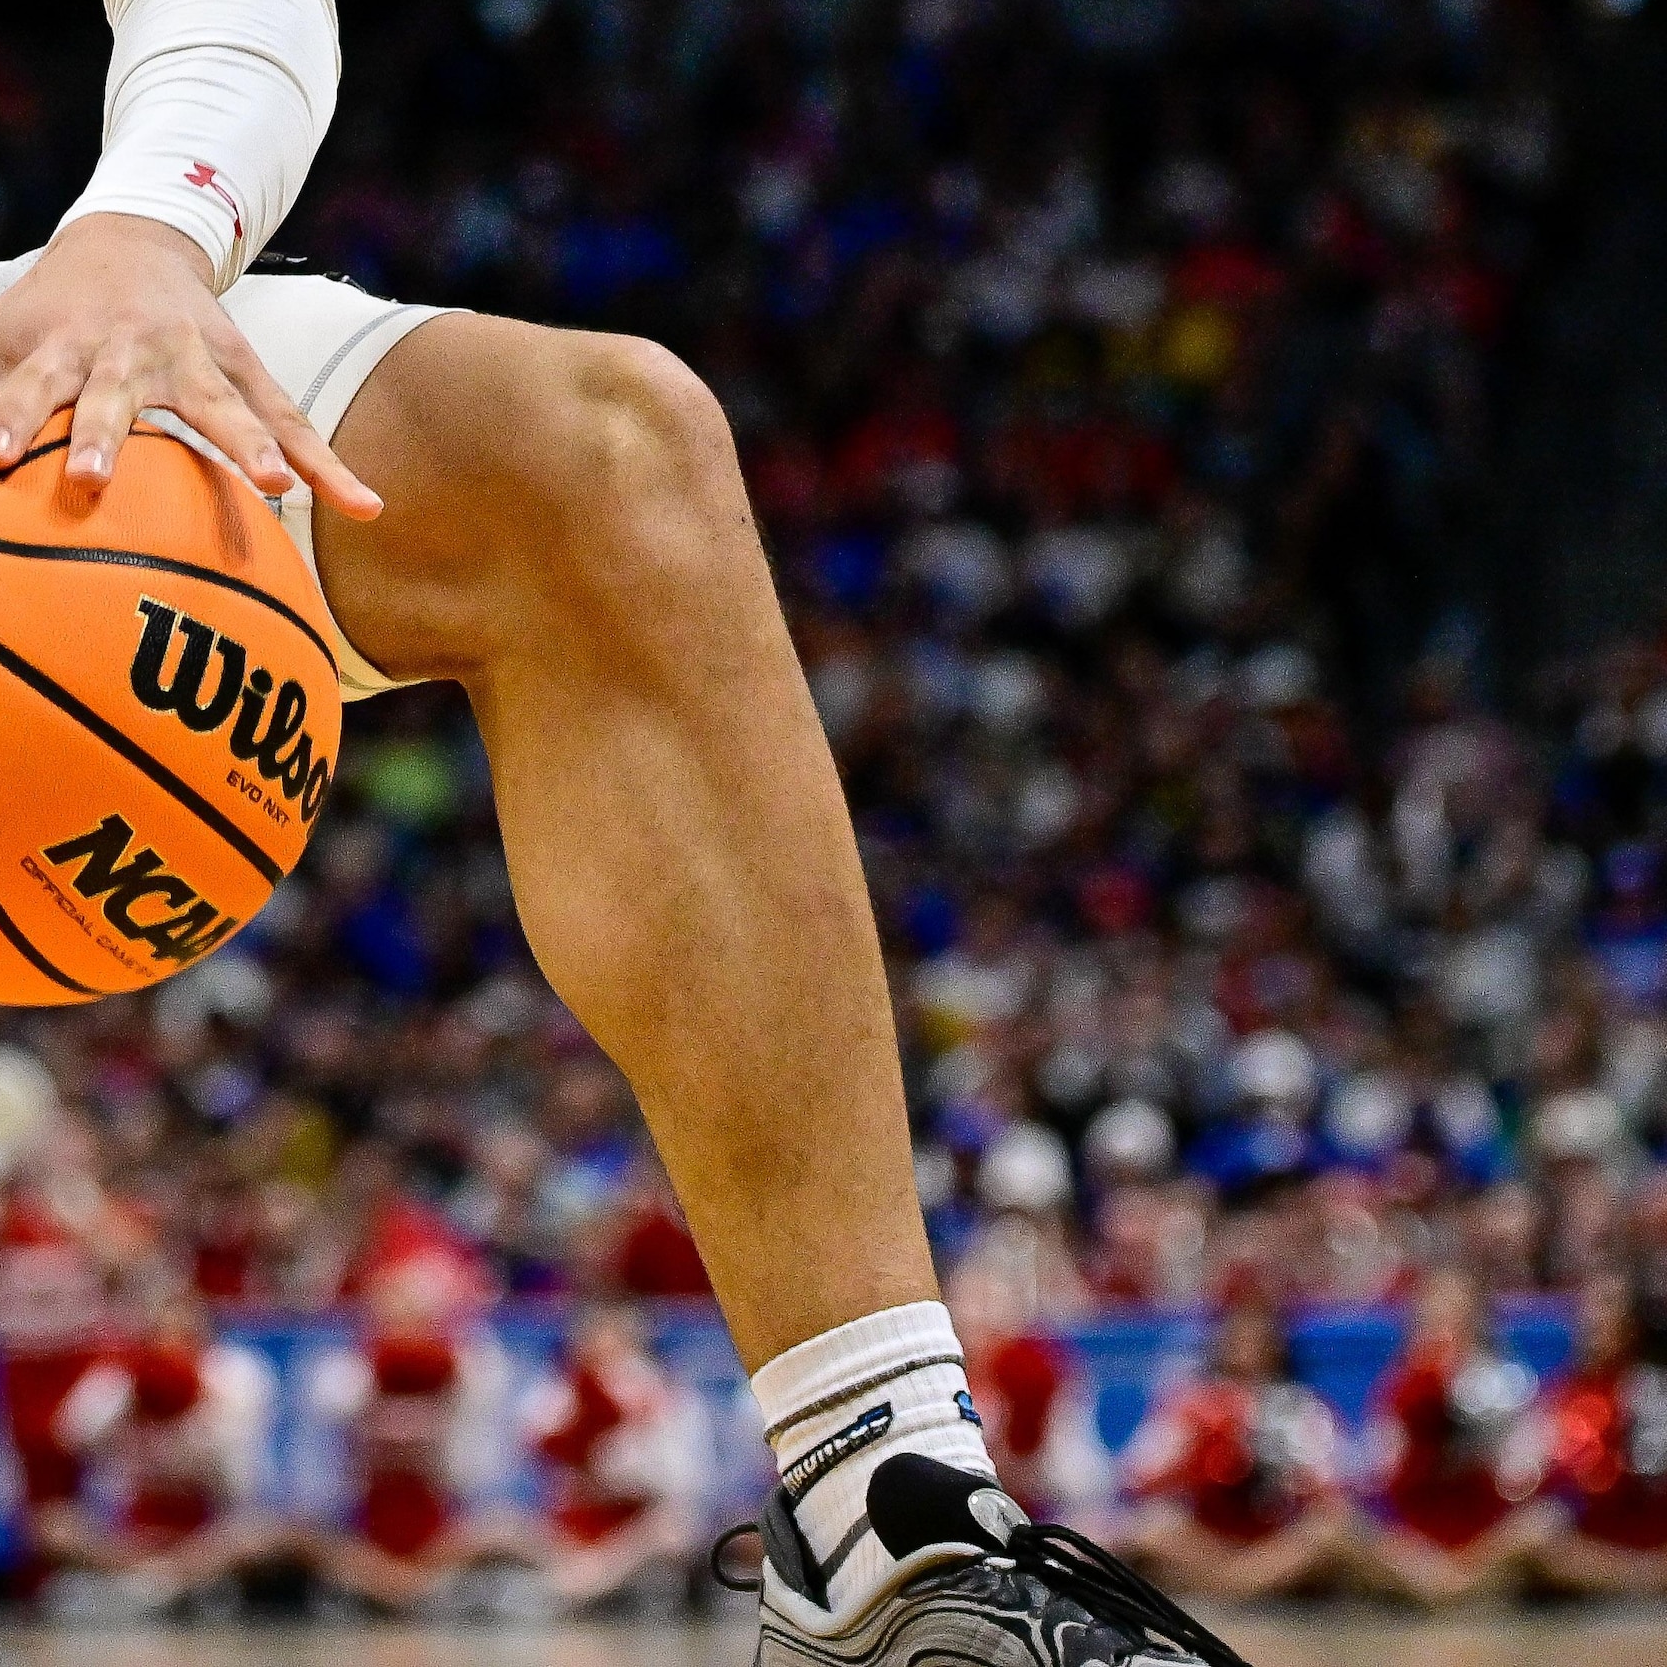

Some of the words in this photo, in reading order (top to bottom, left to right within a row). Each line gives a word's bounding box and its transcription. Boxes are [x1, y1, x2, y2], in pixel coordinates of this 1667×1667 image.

[130, 593, 330, 825] Wilso
[226, 769, 264, 804] EVO
[263, 797, 290, 828] NXT
